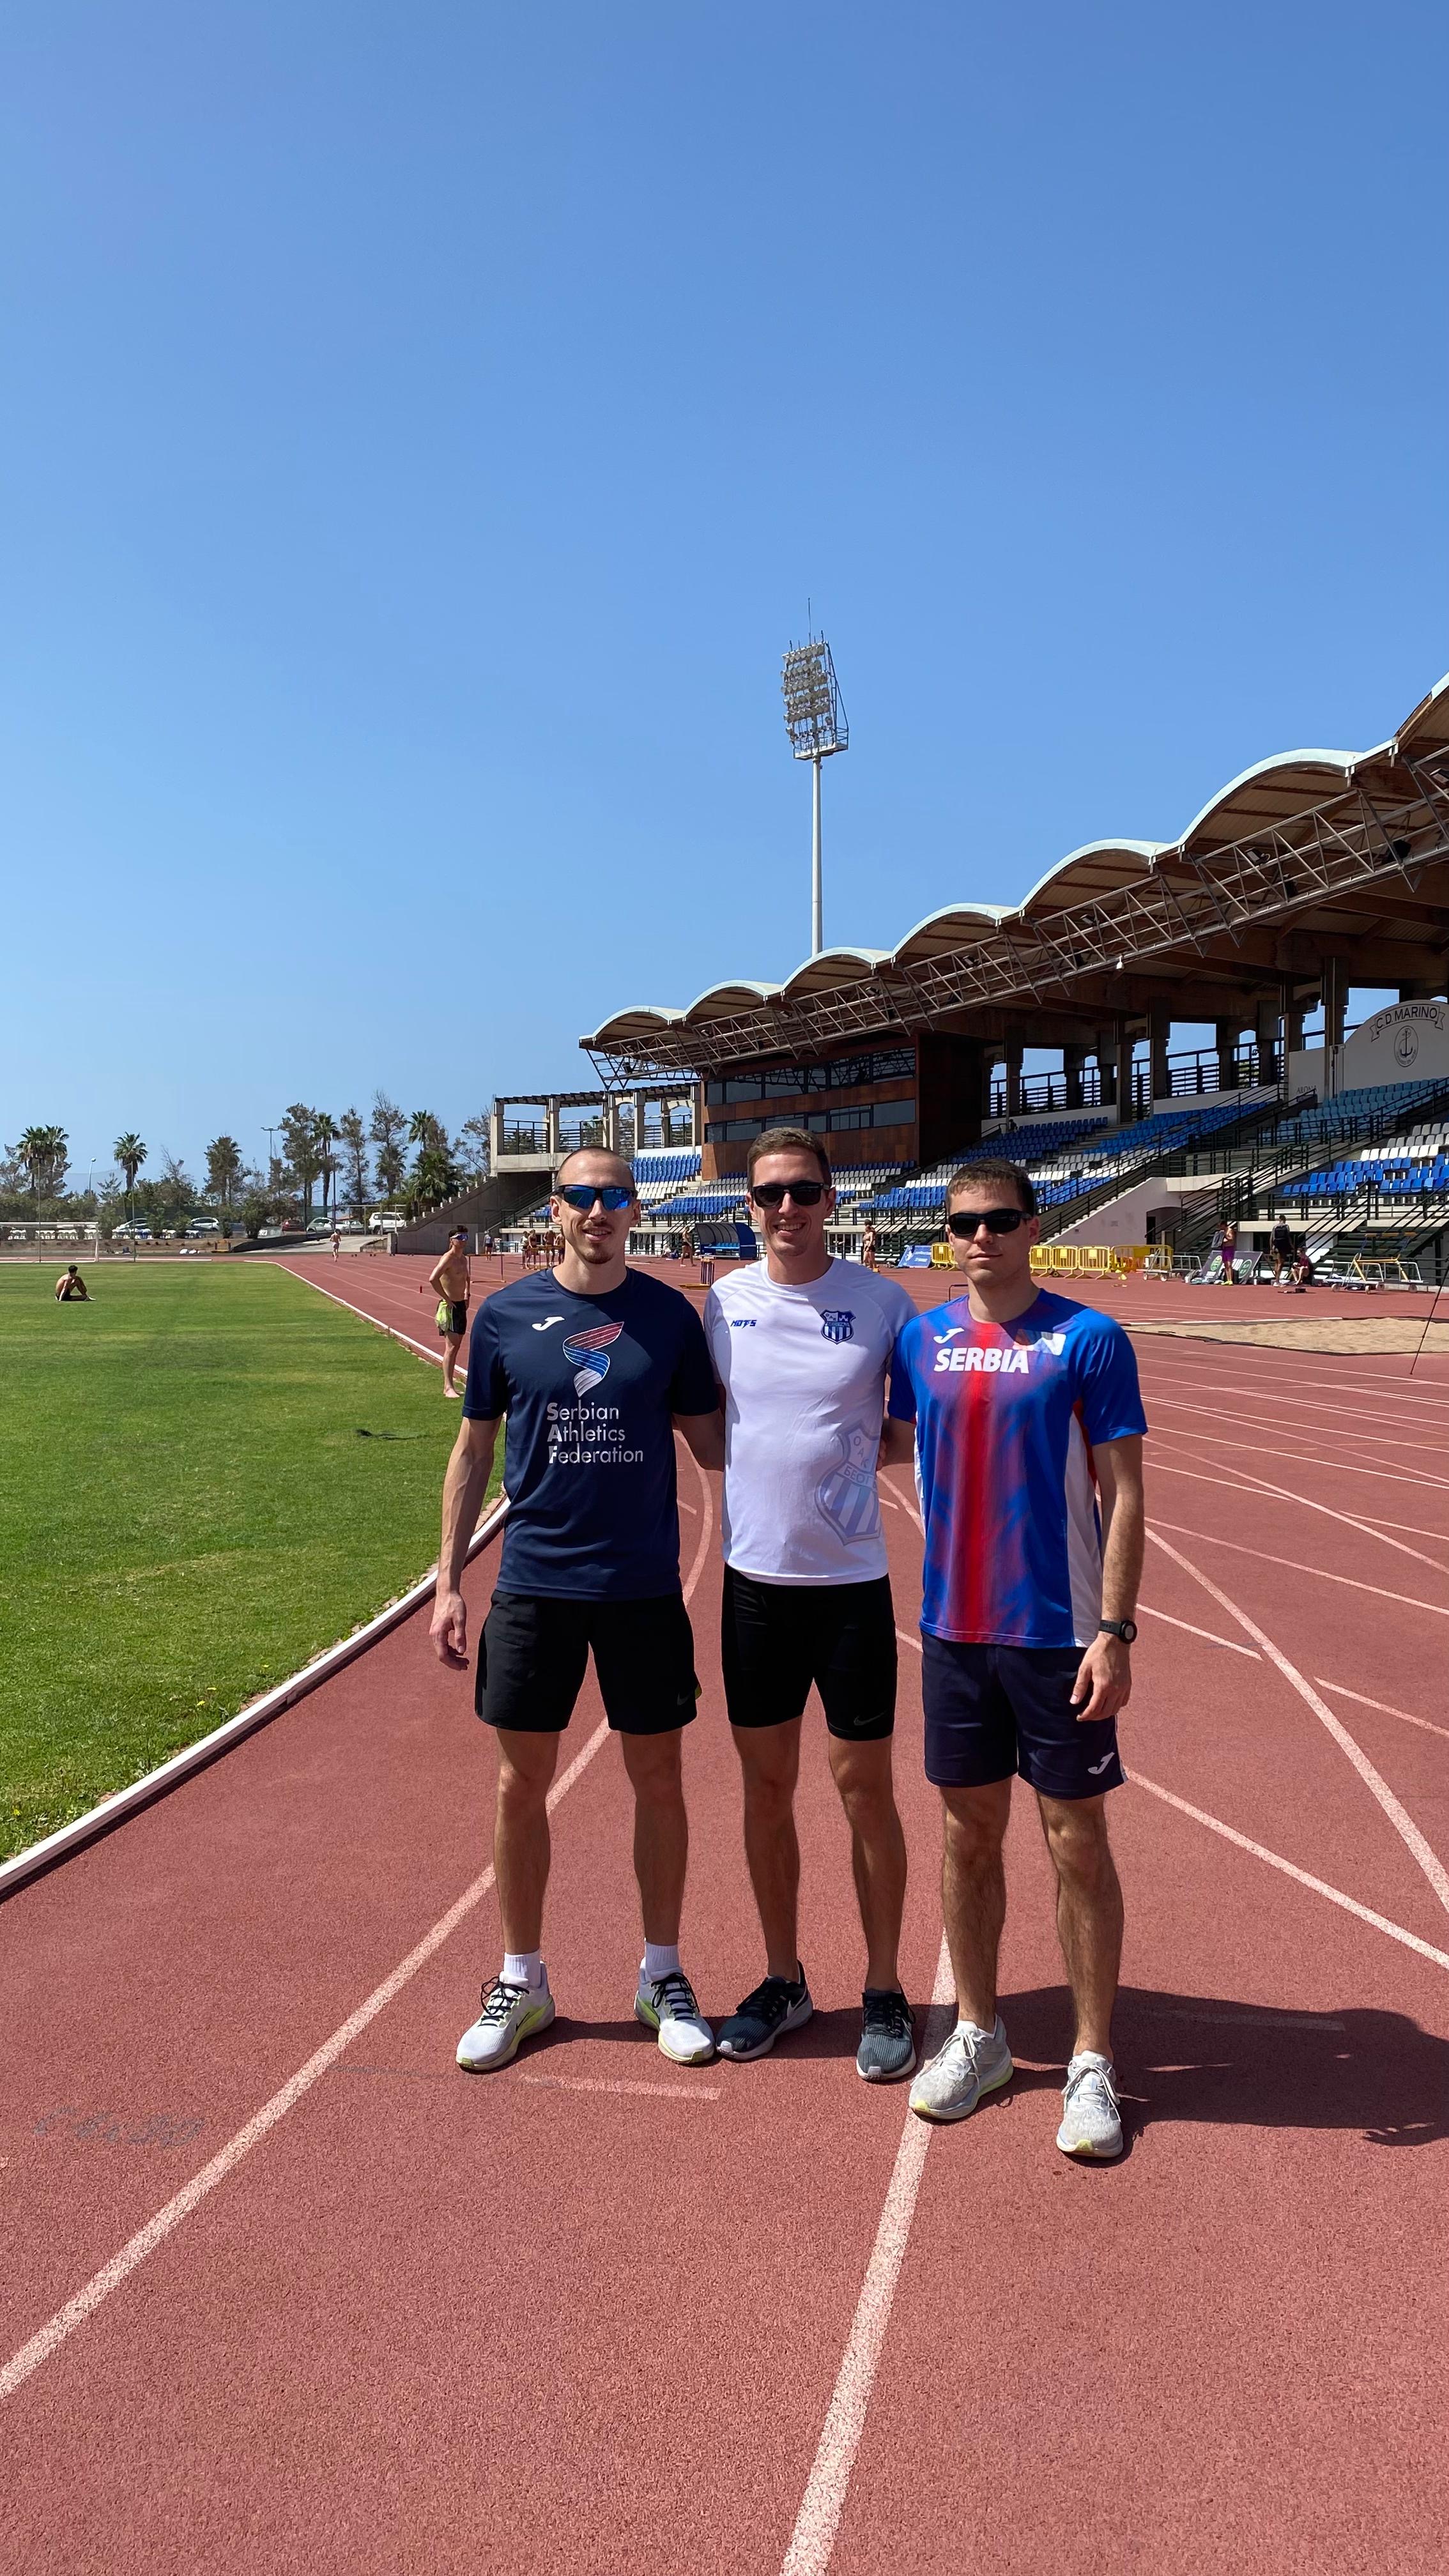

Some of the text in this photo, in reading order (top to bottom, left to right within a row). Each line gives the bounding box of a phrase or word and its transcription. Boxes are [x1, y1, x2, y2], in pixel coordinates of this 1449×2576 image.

[1395, 1006, 1438, 1021] MARINO
[933, 1347, 1029, 1374] SERBIA
[547, 1400, 619, 1421] Serbian
[547, 1422, 625, 1442] Athletics
[548, 1443, 643, 1464] Federation
